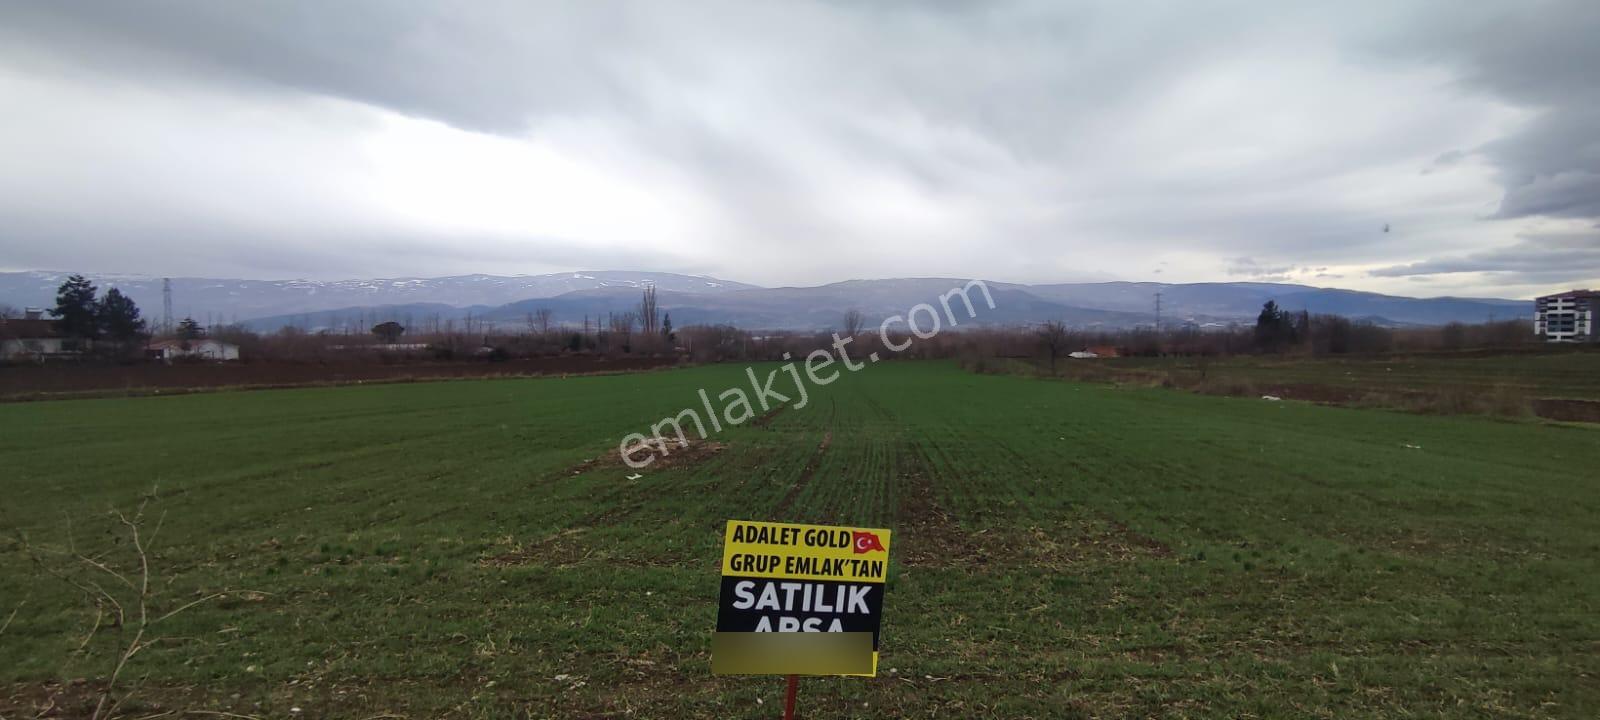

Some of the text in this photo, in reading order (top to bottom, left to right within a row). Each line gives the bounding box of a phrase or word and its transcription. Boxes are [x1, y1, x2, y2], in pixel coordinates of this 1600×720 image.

[732, 525, 851, 548] ADALET GOLD
[730, 553, 883, 578] GRUP EMLAK'TAN
[732, 580, 873, 615] SATILIK
